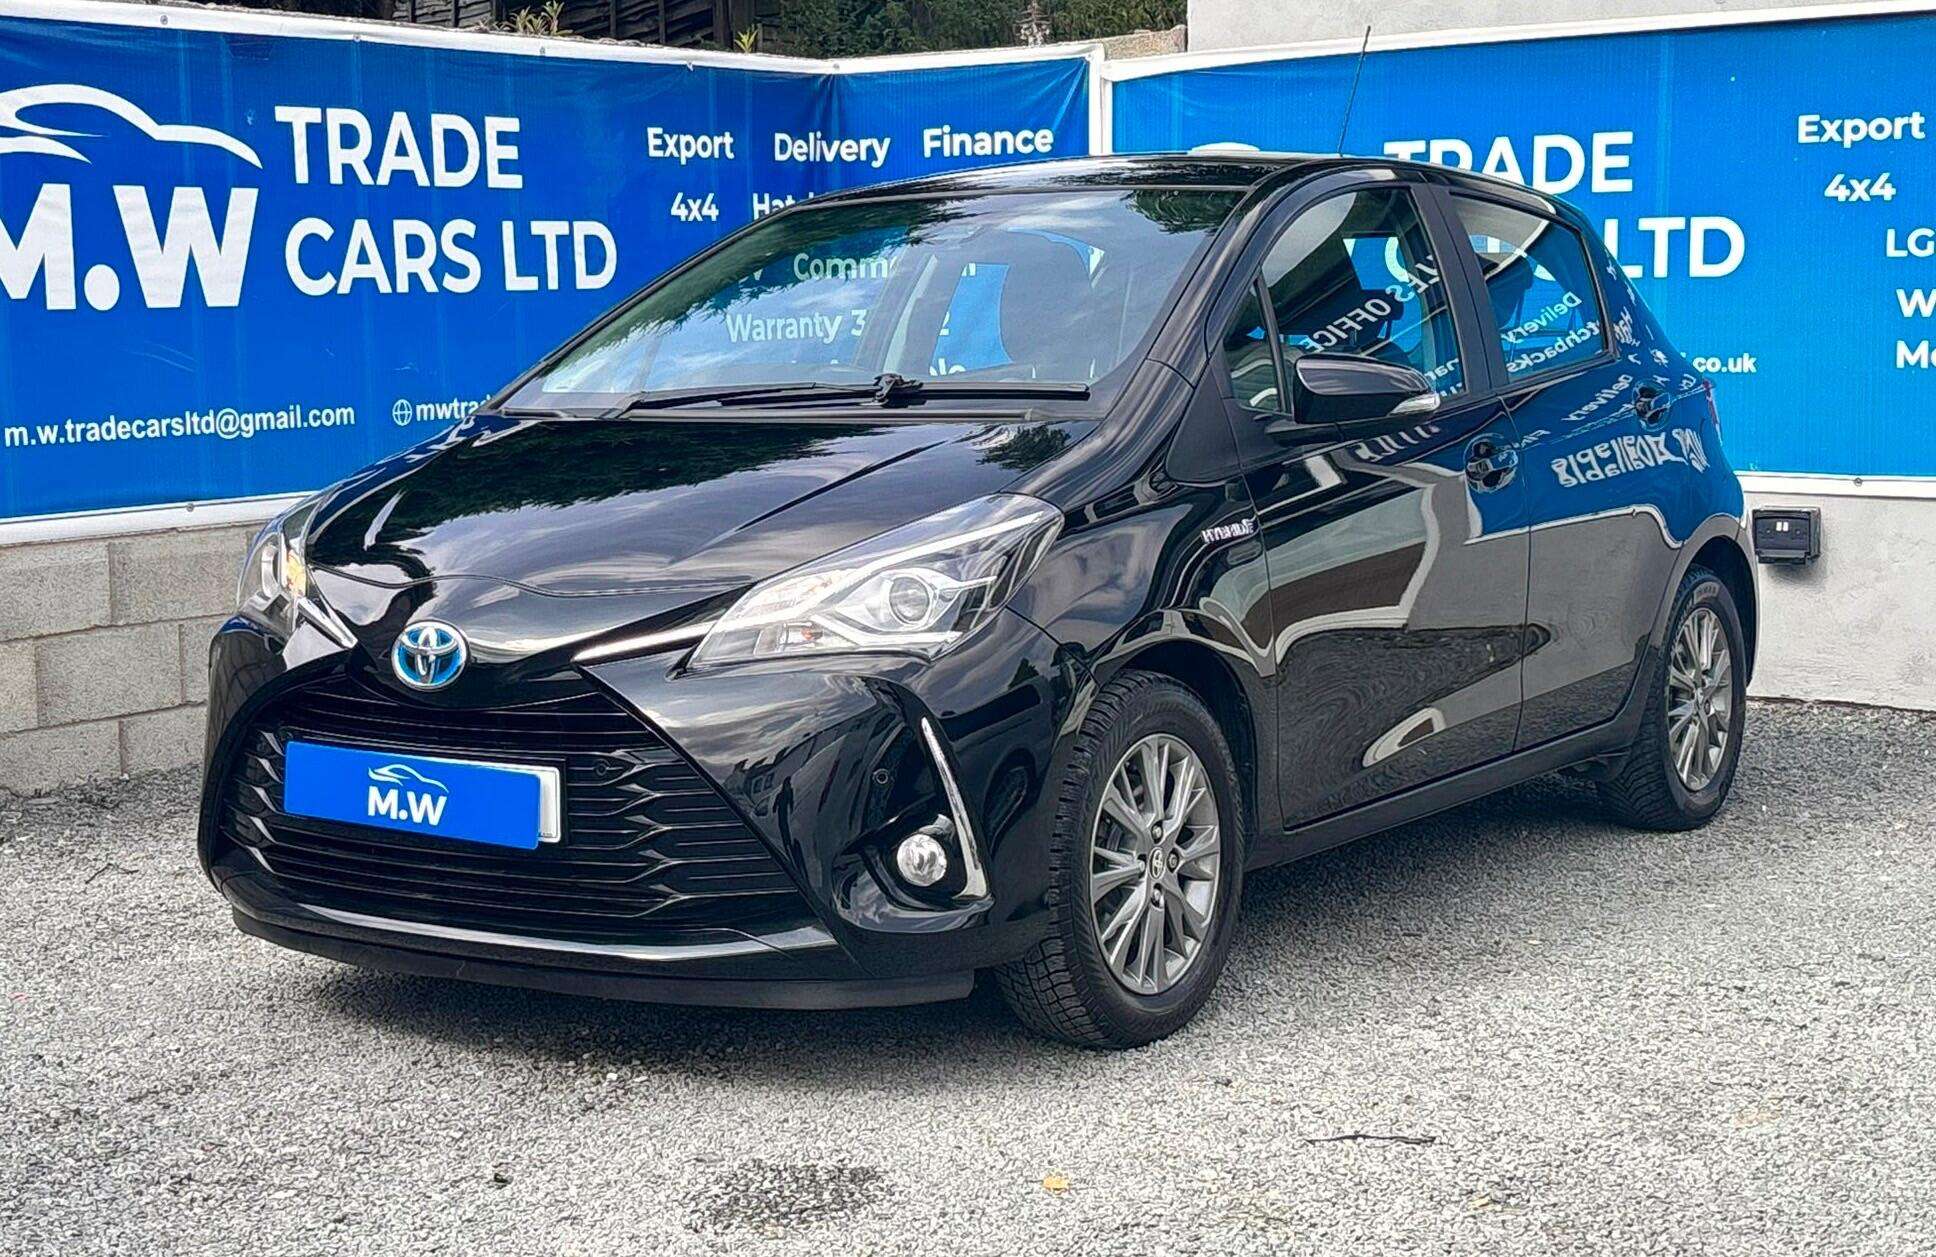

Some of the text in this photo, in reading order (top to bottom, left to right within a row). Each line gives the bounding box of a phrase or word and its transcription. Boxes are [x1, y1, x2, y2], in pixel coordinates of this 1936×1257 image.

[274, 105, 523, 189] TRADE
[647, 127, 734, 164] Export
[923, 124, 1054, 158] Finance
[1797, 111, 1926, 149] Export
[774, 132, 891, 168] Delivery
[1824, 172, 1897, 202] 4x4
[670, 191, 719, 222] 4x4
[285, 217, 618, 296] CARS LTD
[1604, 216, 1746, 278] LTD
[1886, 227, 1936, 258] LG
[726, 310, 842, 344] Warranty
[4, 404, 355, 447] m.w.tradecarsltd@gmail.com
